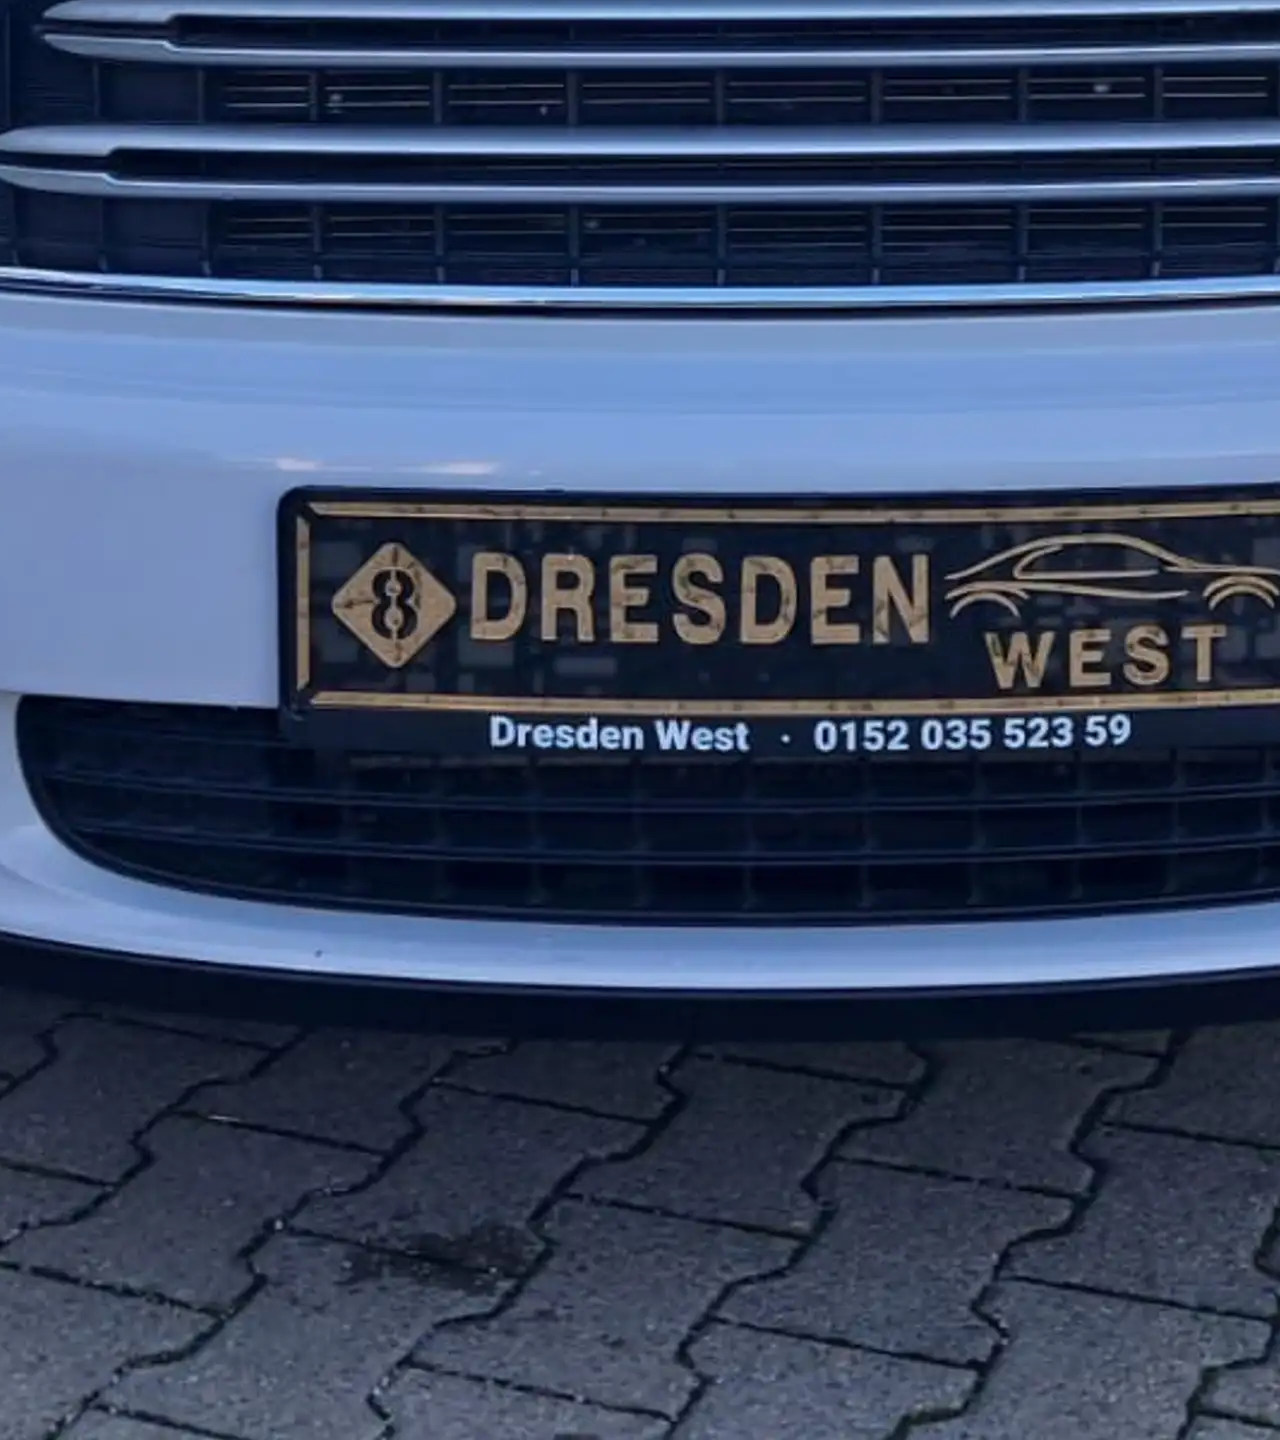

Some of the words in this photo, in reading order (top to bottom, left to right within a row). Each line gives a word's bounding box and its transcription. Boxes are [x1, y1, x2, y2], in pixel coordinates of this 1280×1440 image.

[470, 551, 931, 646] DRESDEN
[984, 624, 1227, 689] WEST
[490, 715, 644, 751] Dresden
[655, 718, 749, 752] West
[814, 719, 909, 751] 0152
[921, 718, 991, 750] 035
[1003, 716, 1073, 748] 523
[1084, 713, 1131, 746] 59
